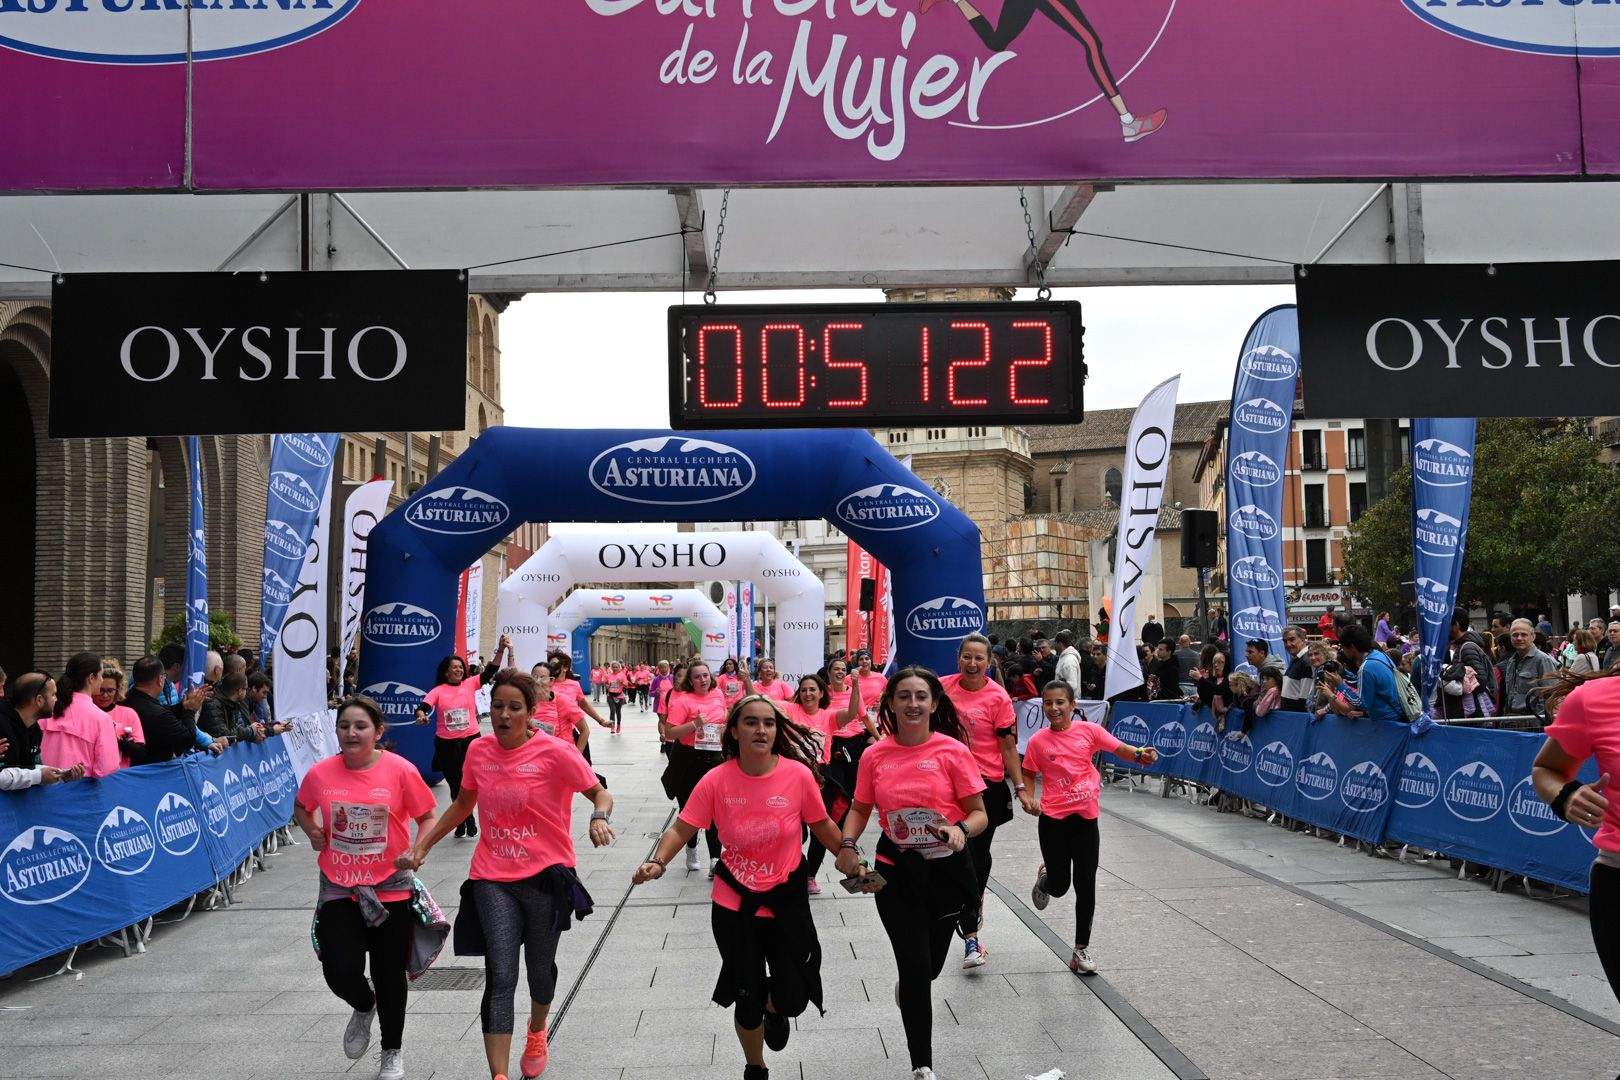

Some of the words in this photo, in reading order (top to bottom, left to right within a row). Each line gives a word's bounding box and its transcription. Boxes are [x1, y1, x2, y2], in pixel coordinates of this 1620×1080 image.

[659, 23, 718, 85] de
[732, 21, 774, 85] la
[766, 11, 1018, 161] Mujer
[120, 326, 408, 382] OYSHO
[1238, 409, 1282, 427] ASTURIANA
[627, 456, 680, 464] CENTRAL
[685, 456, 738, 464] LECHERA
[602, 458, 744, 487] ASTURIANA
[271, 476, 314, 510] ASTURIANA
[411, 503, 501, 523] ASTURIANA
[845, 503, 934, 520] ASTURIANA
[599, 542, 727, 569] OYSHO
[521, 573, 560, 583] OYSHO
[763, 568, 801, 578] OYSHO
[365, 618, 435, 635] ASTURIANA
[503, 625, 539, 635] OYSHO
[783, 621, 819, 631] OYSHO
[912, 614, 981, 631] ASTURIANA
[1400, 777, 1435, 797] TURIANA
[1447, 779, 1499, 810] ASTURIANA
[161, 817, 199, 844] ASTURIANA
[104, 833, 153, 864] ASTURIANA
[332, 852, 387, 865] DORSAL
[7, 853, 87, 893] ASTURIANA
